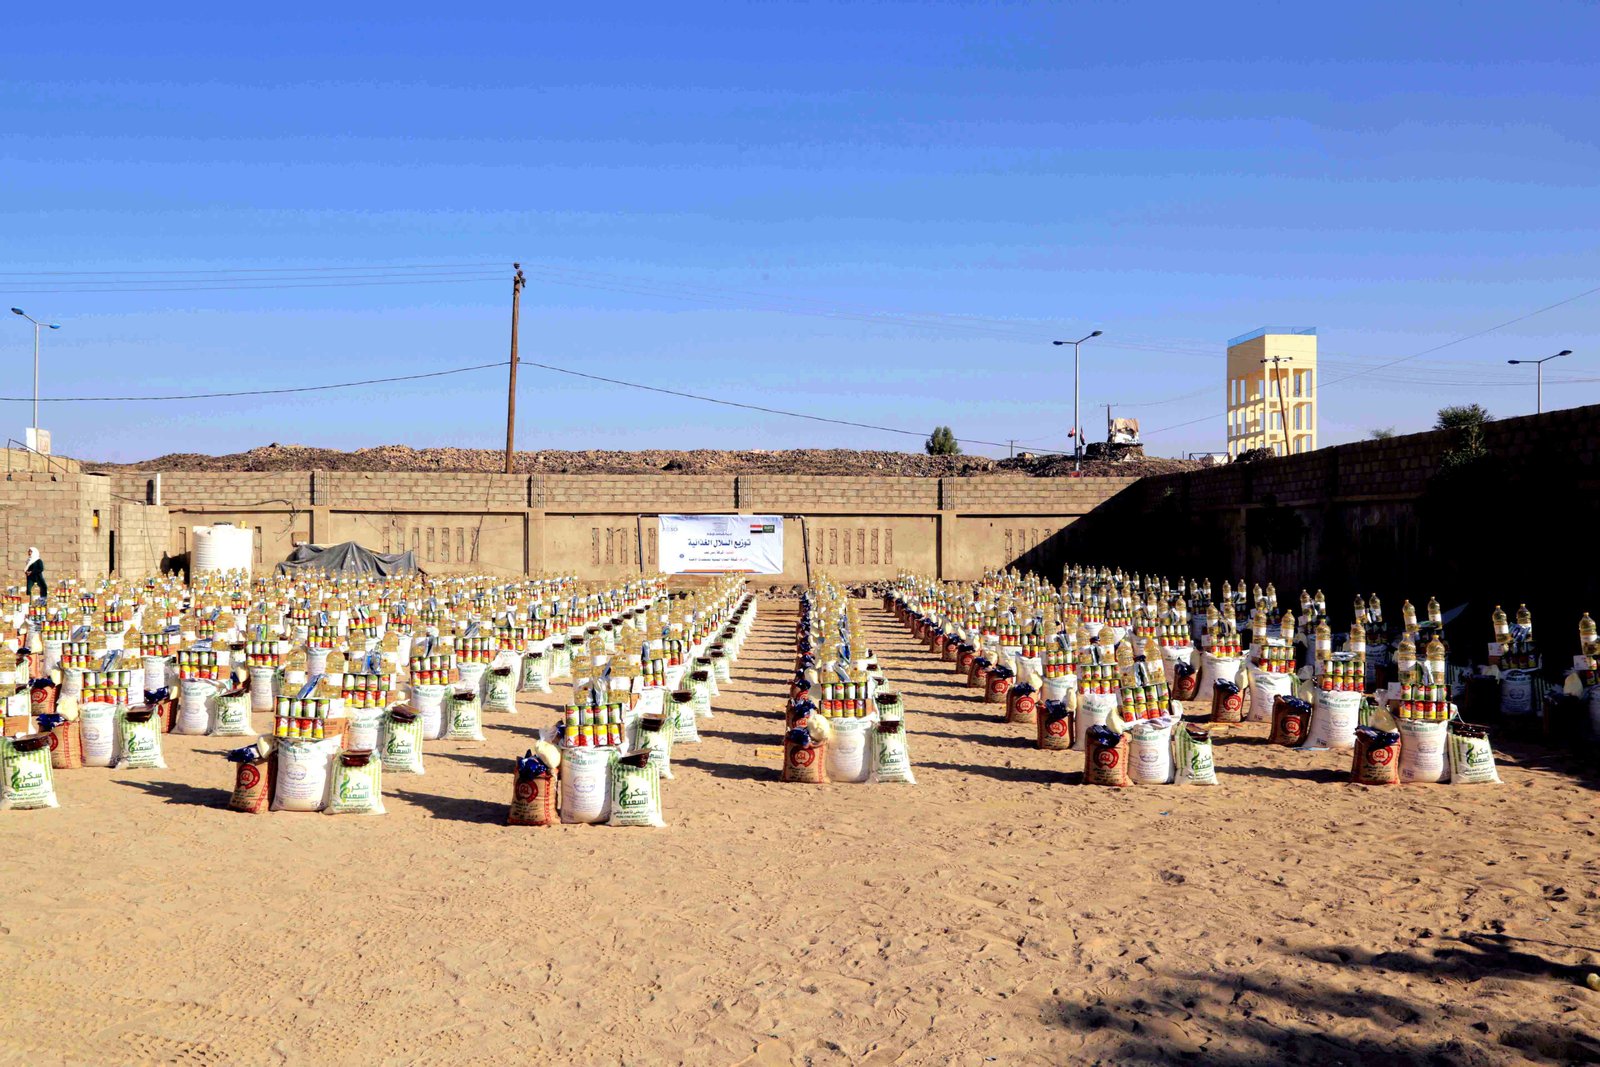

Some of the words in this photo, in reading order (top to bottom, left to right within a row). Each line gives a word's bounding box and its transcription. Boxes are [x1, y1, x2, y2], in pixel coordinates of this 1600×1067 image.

[688, 539, 712, 548] الغذائية
[713, 539, 733, 548] السلال
[734, 539, 751, 548] توزيع
[23, 771, 42, 782] سكر
[351, 783, 369, 792] سكر
[630, 788, 648, 800] سكر
